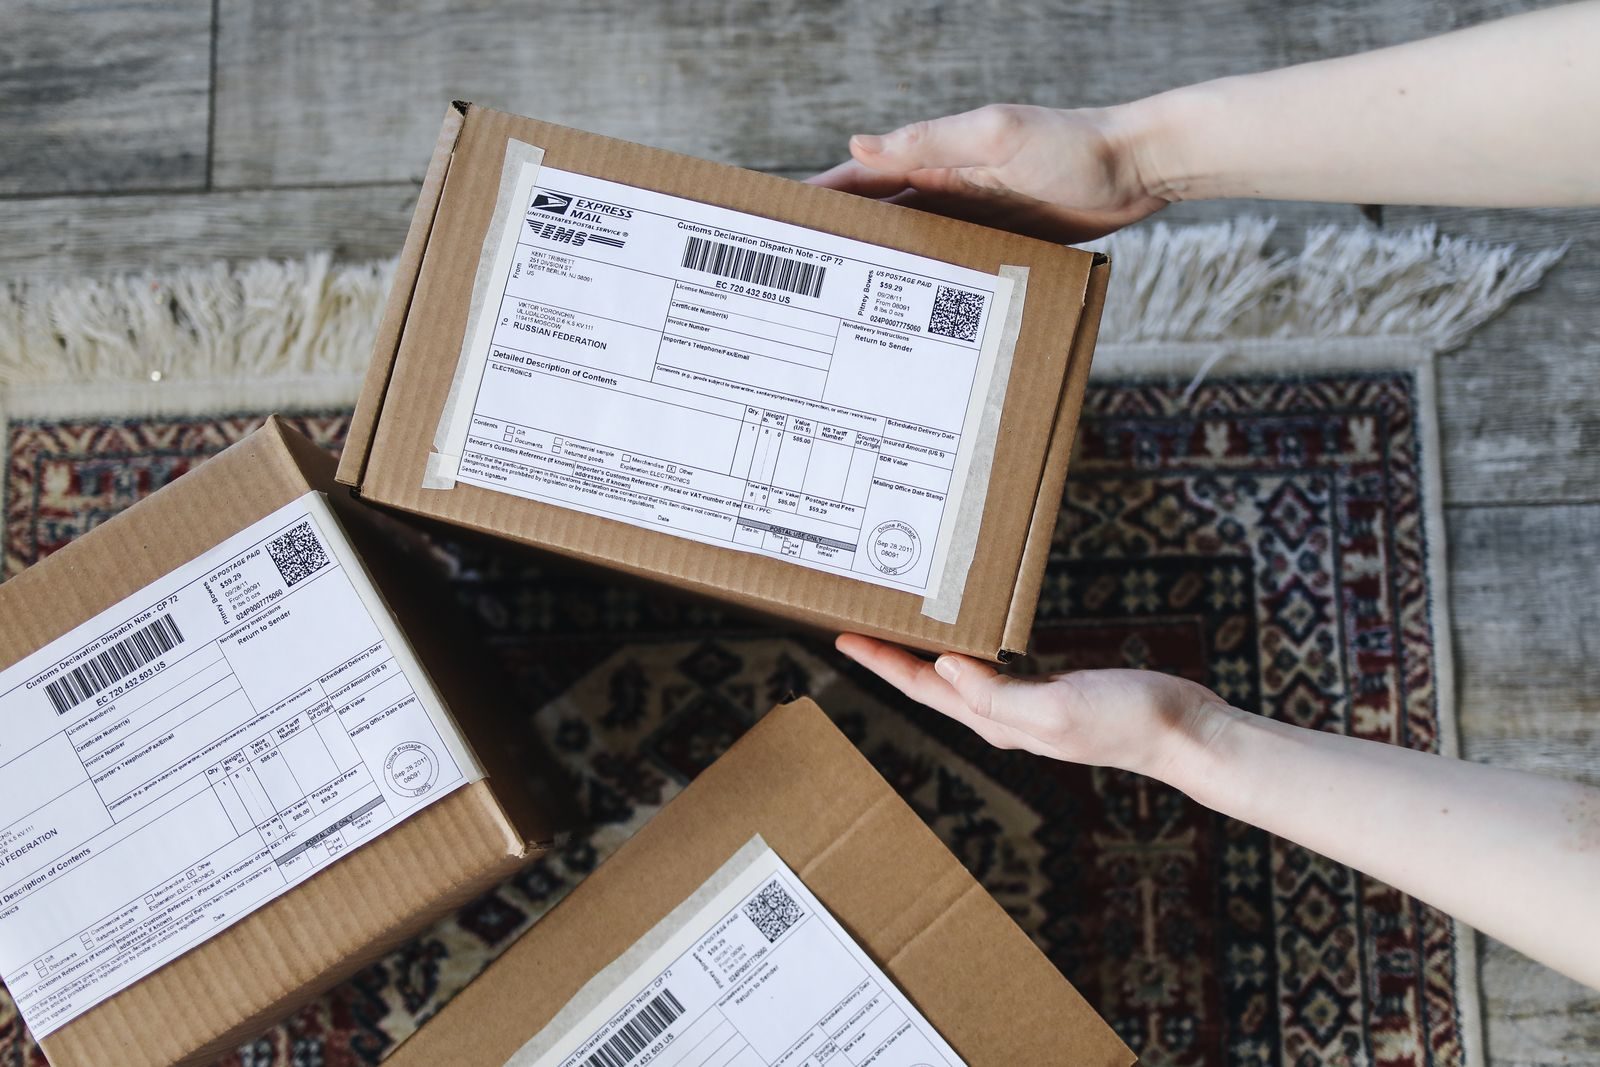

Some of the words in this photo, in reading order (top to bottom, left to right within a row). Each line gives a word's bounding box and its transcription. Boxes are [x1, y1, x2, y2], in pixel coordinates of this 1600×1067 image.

[569, 209, 602, 223] MAIL
[575, 198, 633, 218] EXPRESS
[526, 210, 550, 219] UNITED
[550, 216, 571, 224] STATES
[572, 220, 594, 229] POSTAL
[676, 221, 712, 235] Customs
[713, 229, 757, 246] Declaration
[759, 240, 793, 254] Dispatch
[795, 248, 813, 258] Note
[820, 254, 832, 262] CP
[833, 257, 843, 265] 72
[512, 262, 522, 278] From
[879, 281, 903, 292] $59.29
[884, 272, 915, 284] POSTAGE
[916, 279, 932, 288] PAID
[675, 283, 697, 292] License
[698, 288, 727, 300] Number(s)
[715, 280, 727, 289] EC
[729, 283, 744, 293] 720
[745, 287, 760, 297] 432
[761, 291, 776, 300] 503
[778, 294, 790, 304] US
[857, 294, 869, 316] Pitney
[863, 269, 874, 292] Bowes
[671, 301, 699, 312] Certificate
[699, 307, 728, 320] Number(s)
[875, 298, 890, 306] From
[891, 302, 910, 311] 08091
[533, 318, 562, 329] MOSCOW
[667, 318, 687, 327] Invoice
[688, 322, 710, 332] Number
[842, 321, 876, 334] Nondelivery
[876, 329, 909, 341] Instructions
[869, 314, 921, 332] 024P0007775060
[512, 321, 551, 336] RUSSIAN
[552, 330, 607, 350] FEDERATION
[662, 335, 691, 347] Importer's
[854, 334, 878, 344] Return
[888, 341, 912, 352] Sender
[491, 363, 532, 377] ELECTRONICS
[492, 350, 524, 363] Detailed
[525, 357, 570, 374] Description
[581, 371, 617, 385] Contents
[765, 411, 784, 421] Weight
[794, 418, 810, 426] Value
[887, 419, 917, 431] Scheduled
[917, 426, 941, 438] Delivery
[514, 437, 542, 448] Documents
[856, 433, 880, 444] Country
[882, 438, 904, 448] Insured
[905, 444, 927, 453] Amount
[563, 449, 587, 459] Returned
[587, 455, 604, 463] goods
[631, 457, 664, 469] Merchandise
[892, 458, 908, 466] Value
[872, 479, 893, 489] Mailing
[894, 484, 911, 492] Office
[925, 492, 943, 501] Stamp
[804, 496, 828, 506] Postage
[808, 505, 827, 514] $59.29
[209, 574, 218, 582] US
[217, 557, 246, 578] POSTAGE
[246, 548, 261, 560] PAID
[219, 572, 242, 589] $59.29
[202, 580, 218, 603] Bowes
[215, 603, 230, 624] Pitney
[219, 622, 250, 644] Nondelivery
[249, 604, 281, 625] Instructions
[237, 628, 259, 645] Return
[267, 609, 290, 626] Sender
[25, 666, 60, 690] Customs
[59, 641, 101, 670] Declaration
[100, 622, 134, 645] Dispatch
[134, 611, 152, 625] Note
[156, 600, 168, 611] CP
[168, 594, 179, 604] 72
[319, 663, 348, 683] Scheduled
[347, 651, 370, 667] Delivery
[369, 644, 381, 654] Date
[95, 695, 108, 706] EC
[108, 685, 123, 698] 720
[123, 676, 138, 689] 432
[138, 667, 153, 680] 503
[153, 660, 166, 672] US
[67, 720, 88, 736] License
[87, 703, 116, 724] Number(s)
[84, 753, 104, 768] Invoice
[103, 740, 125, 756] Number
[4, 827, 58, 863] FEDERATION
[2, 873, 47, 903] Description
[47, 867, 56, 876] of
[56, 847, 90, 871] Contents
[734, 987, 754, 1005] Return
[759, 964, 778, 983] Sender
[574, 1026, 610, 1059] Declaration
[608, 1002, 637, 1029] Dispatch
[635, 989, 651, 1004] Note
[653, 976, 664, 988] CP
[662, 969, 672, 979] 72
